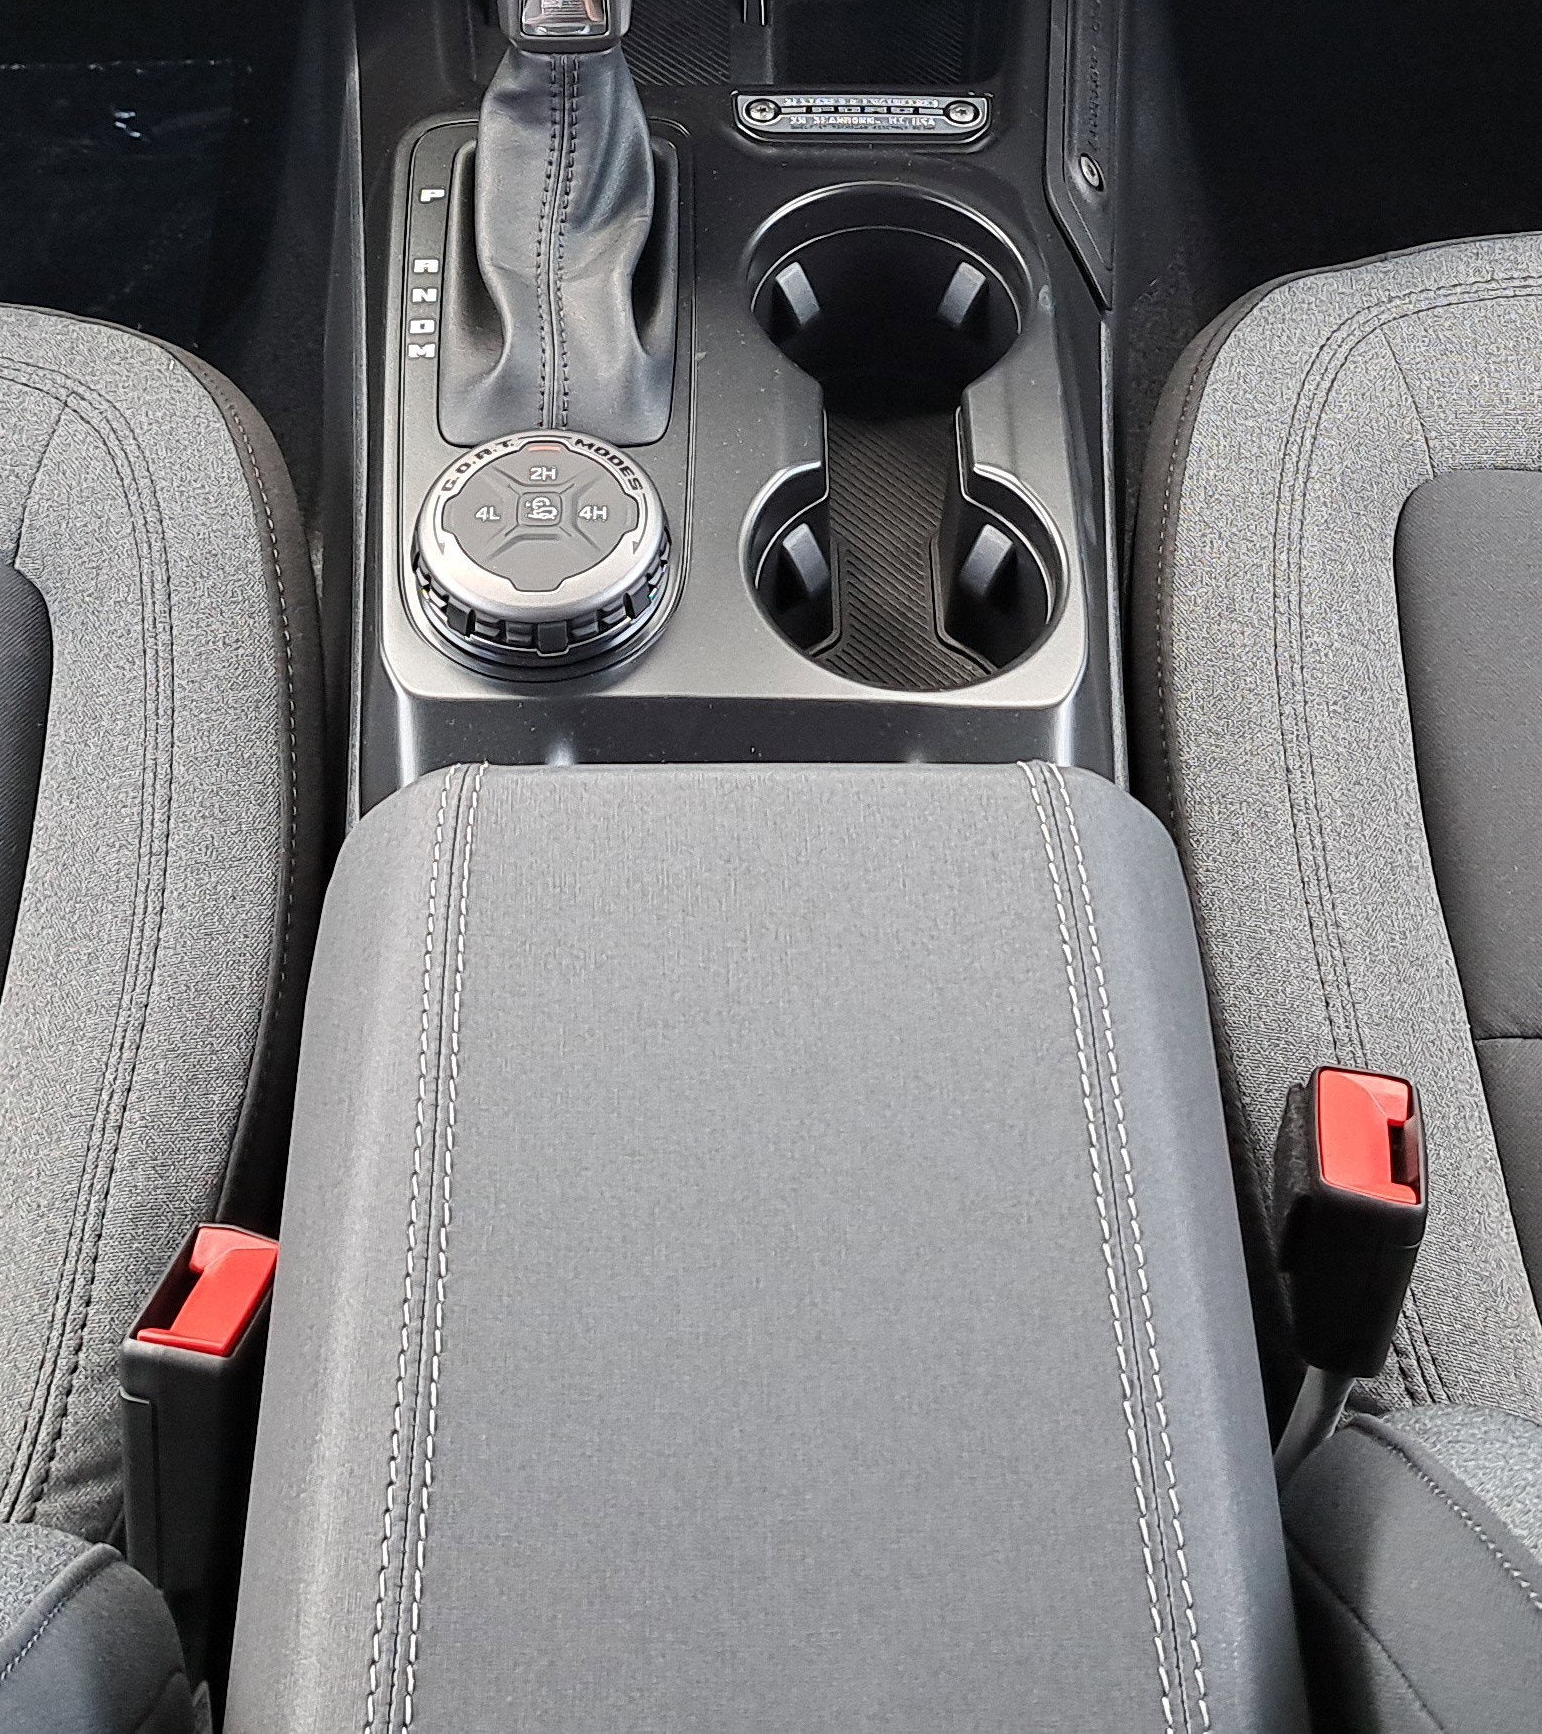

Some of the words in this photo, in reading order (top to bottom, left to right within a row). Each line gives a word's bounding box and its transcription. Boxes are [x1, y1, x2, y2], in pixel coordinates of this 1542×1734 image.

[420, 188, 446, 203] P
[413, 258, 440, 273] R
[412, 288, 438, 303] N
[409, 319, 436, 334] D
[408, 343, 437, 359] M
[574, 438, 645, 492] MODES
[529, 466, 557, 482] 2H
[475, 506, 502, 522] 4L
[578, 505, 608, 522] 4H
